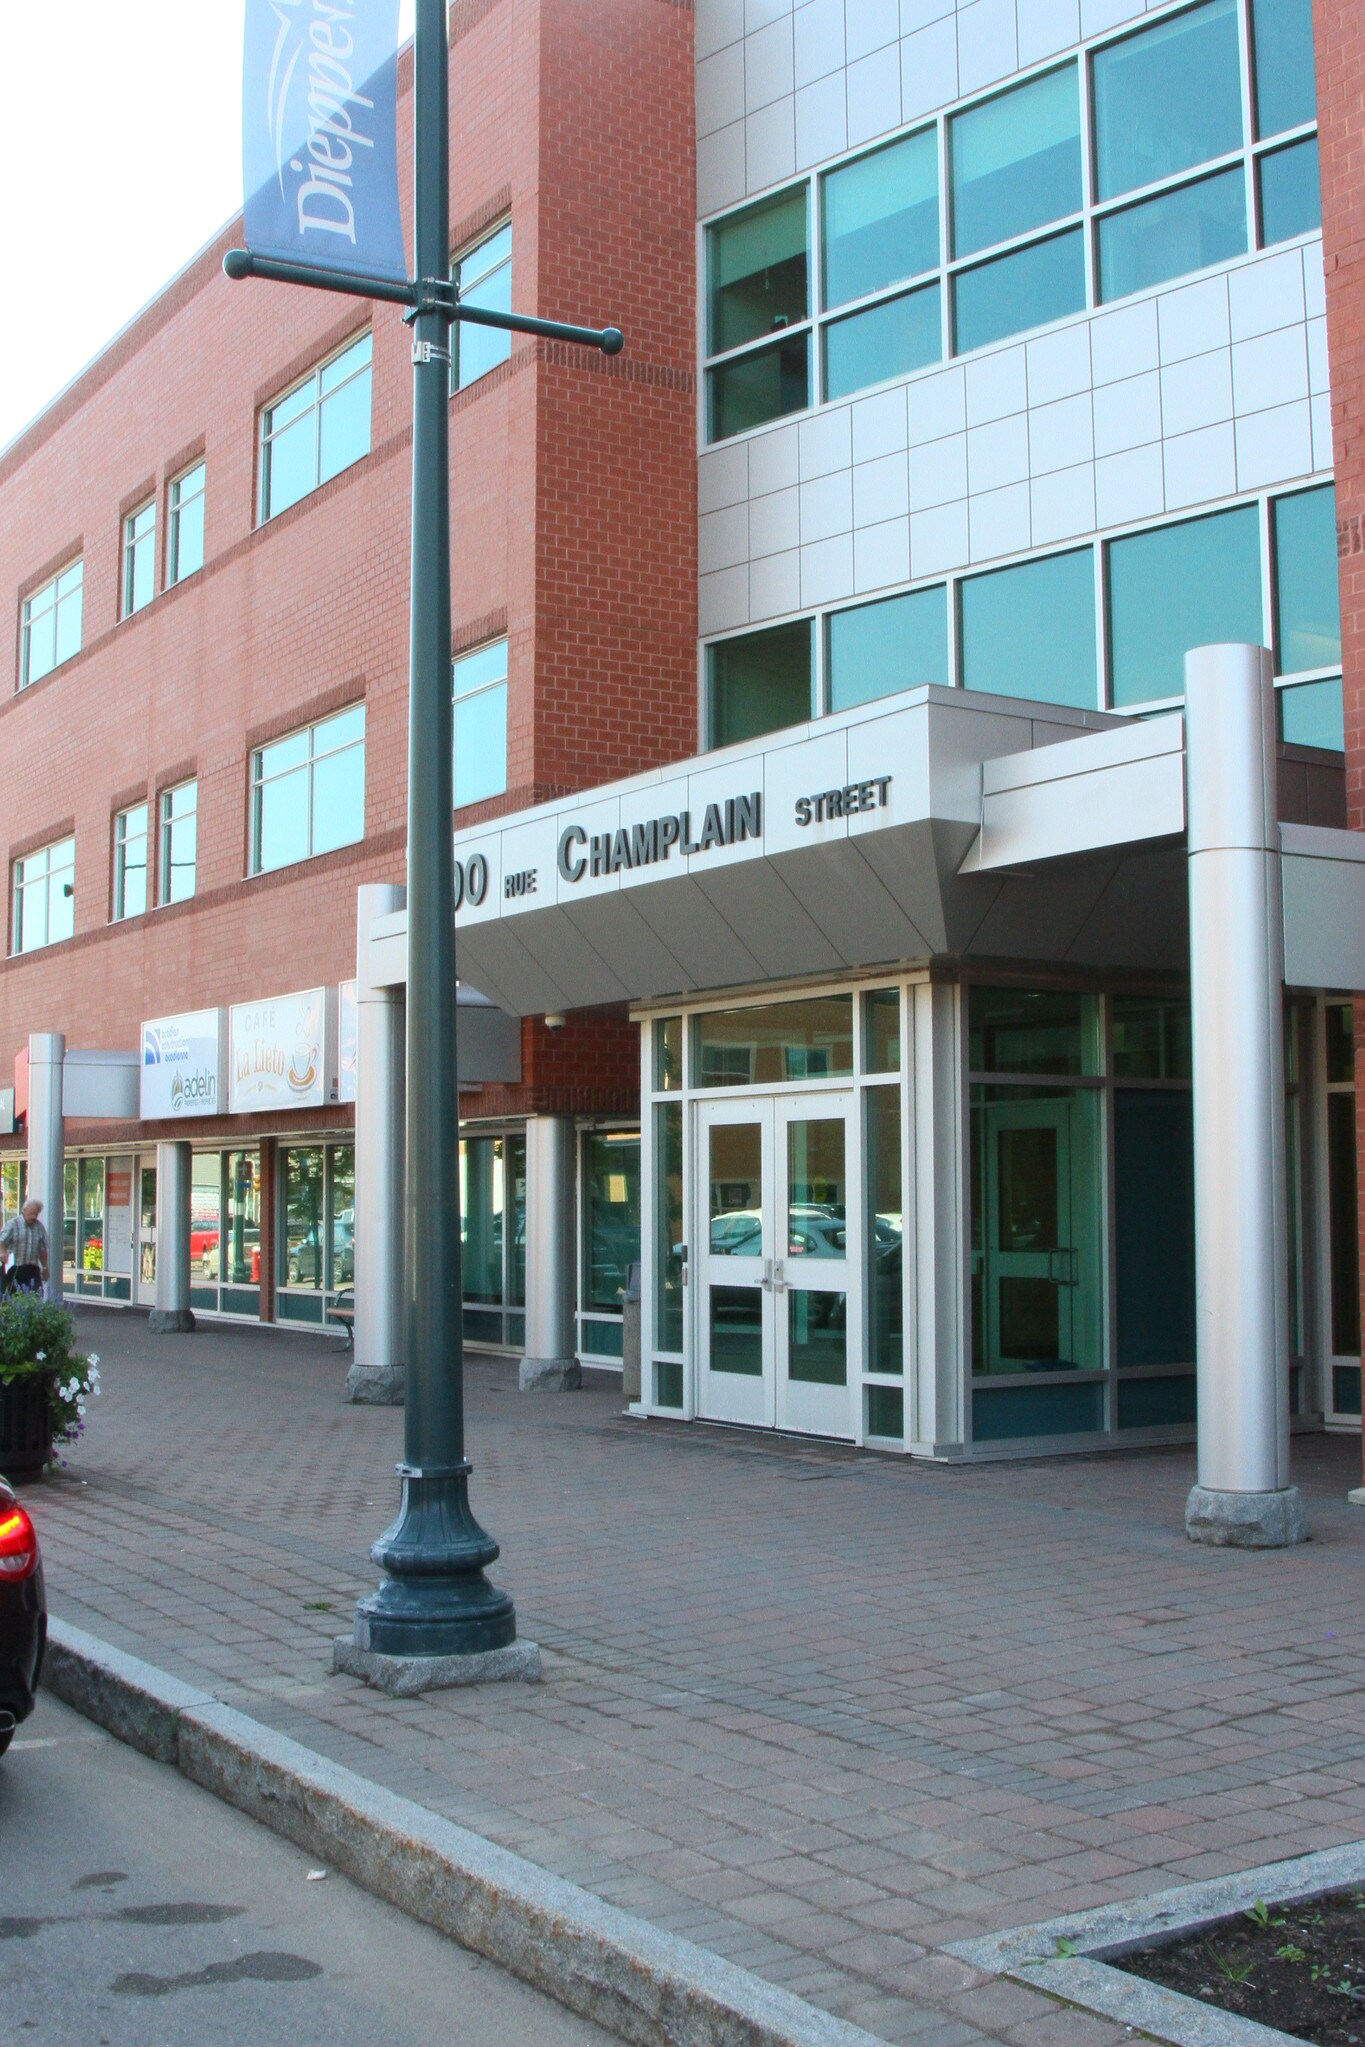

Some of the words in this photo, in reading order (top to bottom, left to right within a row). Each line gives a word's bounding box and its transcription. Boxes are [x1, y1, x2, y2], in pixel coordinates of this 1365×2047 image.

[290, 19, 374, 245] Dieppe
[503, 868, 538, 899] RUE
[557, 791, 762, 883] CHAMPLAIN
[794, 775, 893, 827] STREET
[244, 1006, 277, 1033] CAFÉ
[184, 1067, 216, 1099] adelin
